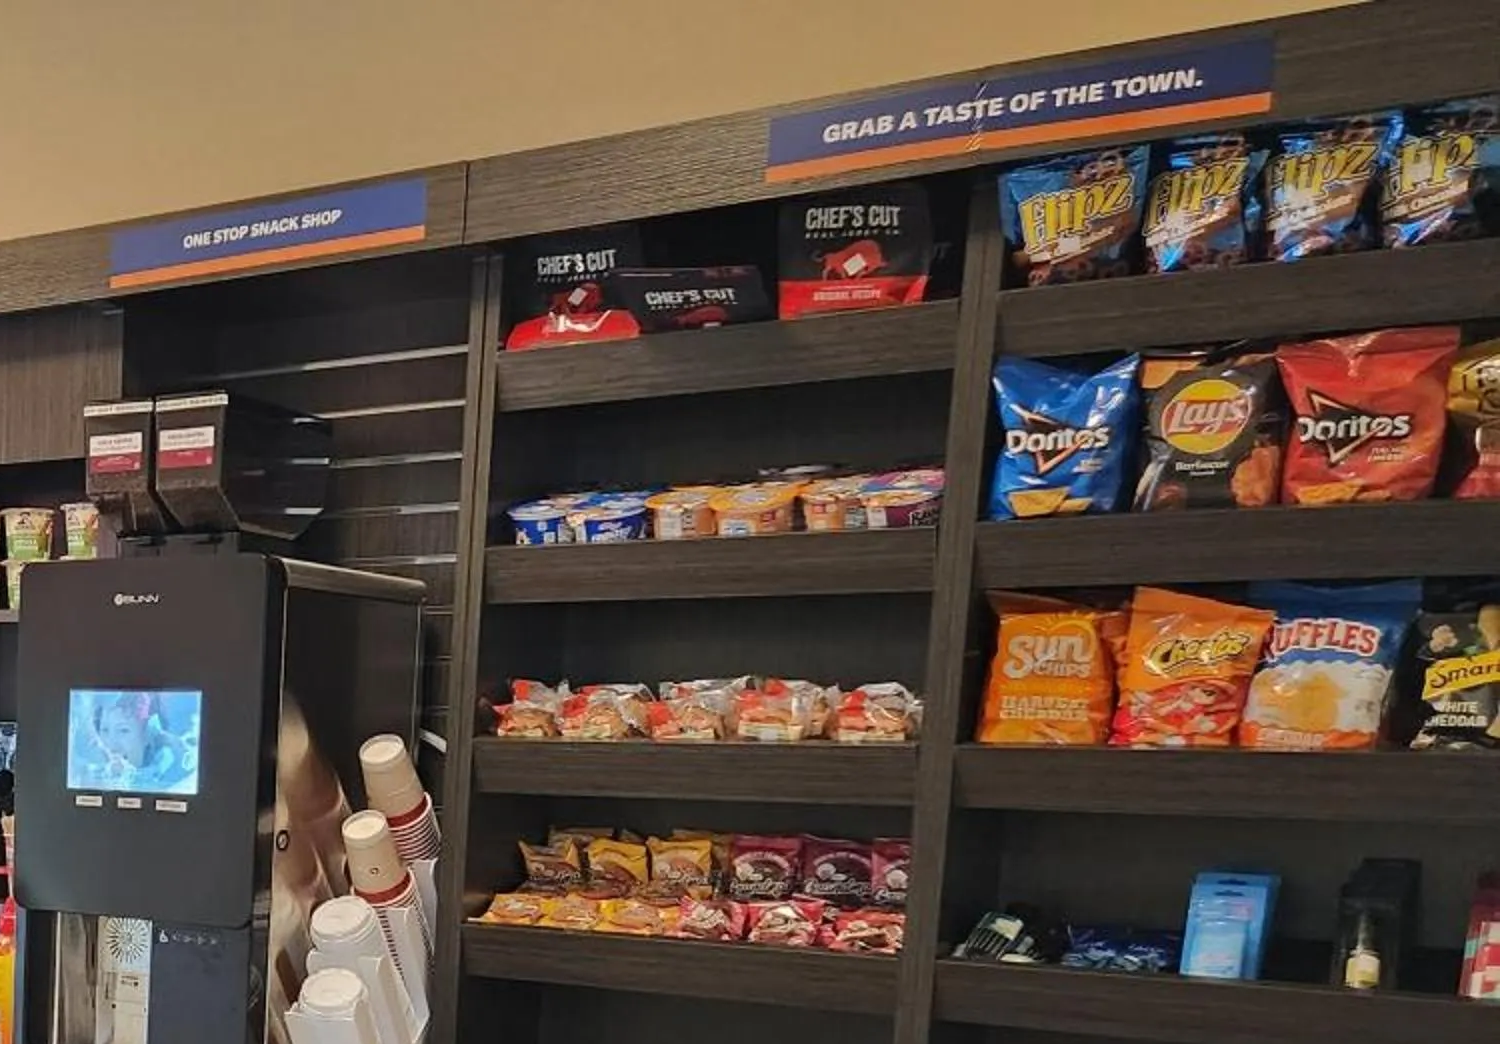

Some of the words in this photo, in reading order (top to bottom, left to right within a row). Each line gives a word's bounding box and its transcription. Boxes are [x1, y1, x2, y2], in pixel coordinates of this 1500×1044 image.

[823, 113, 894, 144] GRAB
[898, 111, 917, 131] A
[924, 96, 1005, 127] TASTE
[1010, 91, 1039, 114] OF
[1051, 82, 1105, 106] THE
[1112, 68, 1203, 99] TOWN.
[805, 205, 864, 230] CHEF'S
[868, 204, 901, 227] CUT
[1020, 174, 1133, 252] Flipz
[183, 232, 212, 249] ONE
[213, 225, 249, 244] STOP
[250, 216, 300, 238] SNACK
[301, 209, 343, 229] SHOP
[537, 253, 585, 275] CHEF'S
[586, 249, 616, 272] CUT
[702, 287, 737, 301] CUT
[1006, 426, 1109, 454] Doritos
[1271, 618, 1380, 656] UFFLES
[1032, 662, 1091, 678] CHIPS
